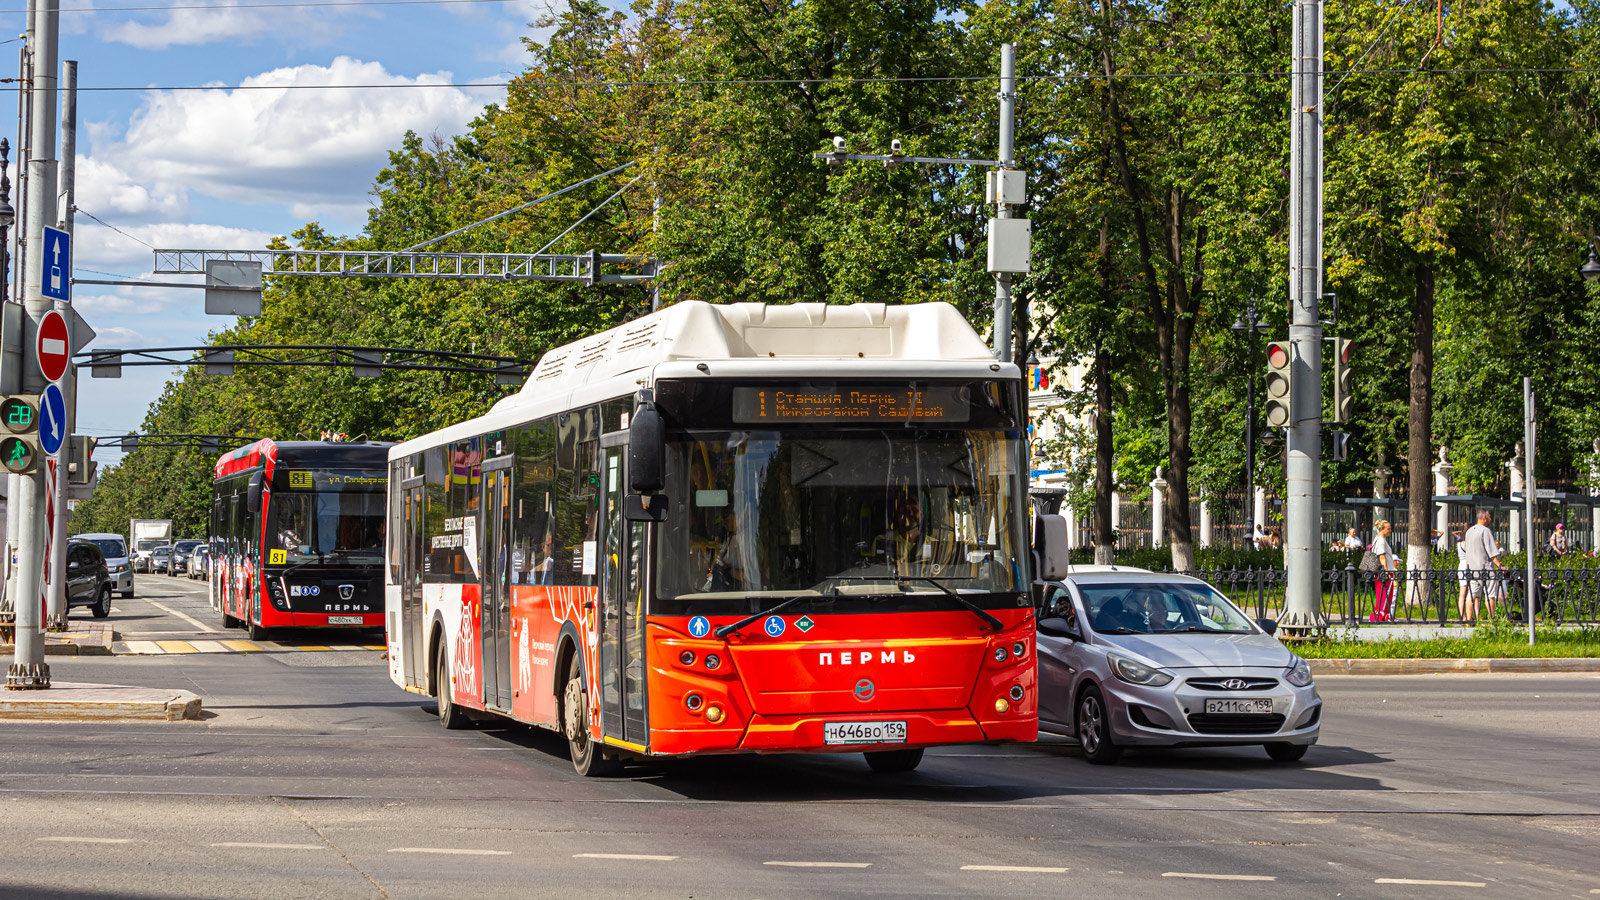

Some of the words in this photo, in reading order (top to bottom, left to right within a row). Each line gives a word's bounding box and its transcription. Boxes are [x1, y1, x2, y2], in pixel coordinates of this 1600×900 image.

[759, 391, 767, 416] 1
[776, 391, 841, 404] Станция
[850, 391, 897, 404] Пермь
[9, 405, 31, 424] 28
[776, 404, 870, 417] Микрорайон
[878, 404, 943, 417] Садовый
[273, 553, 284, 563] 81
[819, 651, 915, 665] ПЕРМЬ
[1254, 701, 1269, 710] 159
[830, 725, 881, 738] Н646ВО
[884, 723, 903, 734] 159
